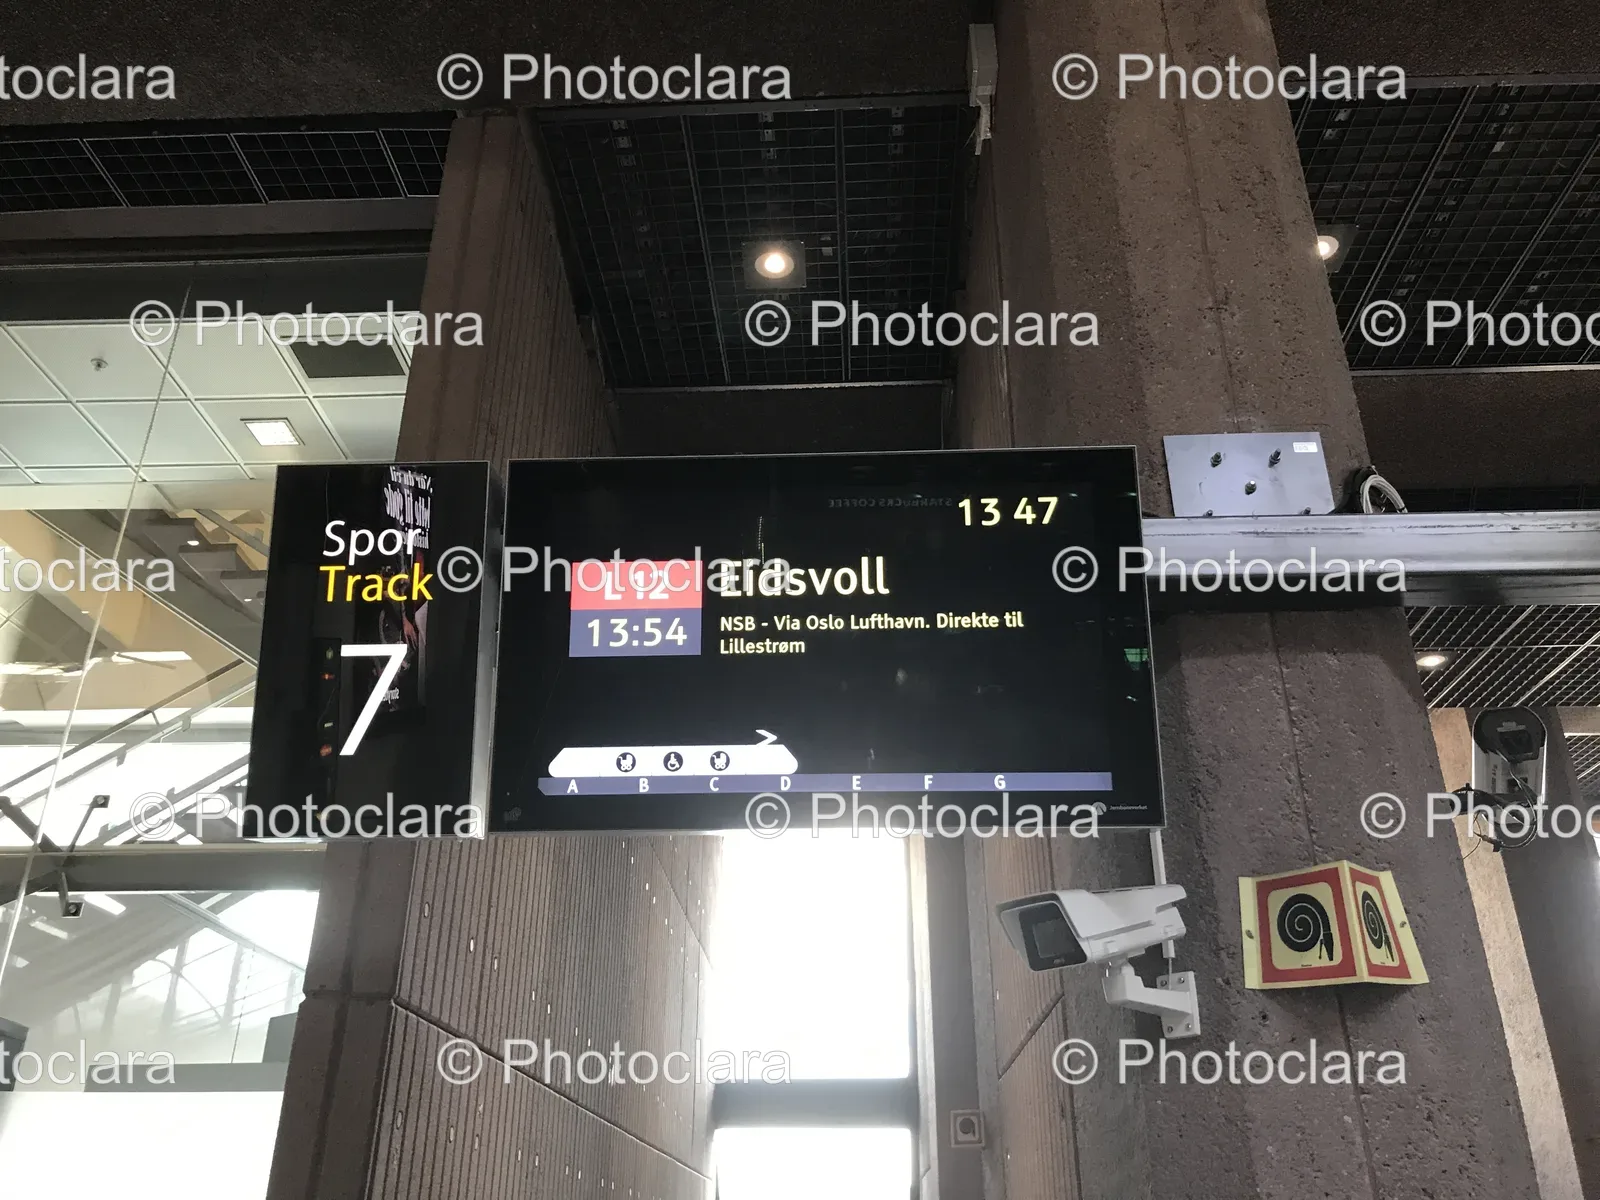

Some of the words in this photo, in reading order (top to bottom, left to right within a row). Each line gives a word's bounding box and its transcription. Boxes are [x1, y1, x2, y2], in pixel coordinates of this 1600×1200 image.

[323, 520, 422, 566] Spor
[319, 562, 433, 602] Track
[604, 571, 622, 600] L
[634, 570, 669, 600] 12
[720, 556, 891, 597] Eidsvoll
[587, 618, 688, 647] 13:54
[720, 616, 756, 631] NSB
[774, 615, 800, 630] Via
[806, 614, 845, 630] Oslo
[850, 613, 930, 630] Lufthavn.
[936, 612, 999, 629] Direkte
[1004, 611, 1024, 628] til
[720, 638, 805, 654] Lillestrøm
[339, 643, 407, 756] 7
[567, 779, 579, 794] A
[638, 778, 650, 793] B
[709, 777, 721, 792] C
[780, 776, 792, 791] D
[852, 775, 864, 790] E
[923, 775, 935, 790] F
[994, 774, 1006, 789] G
